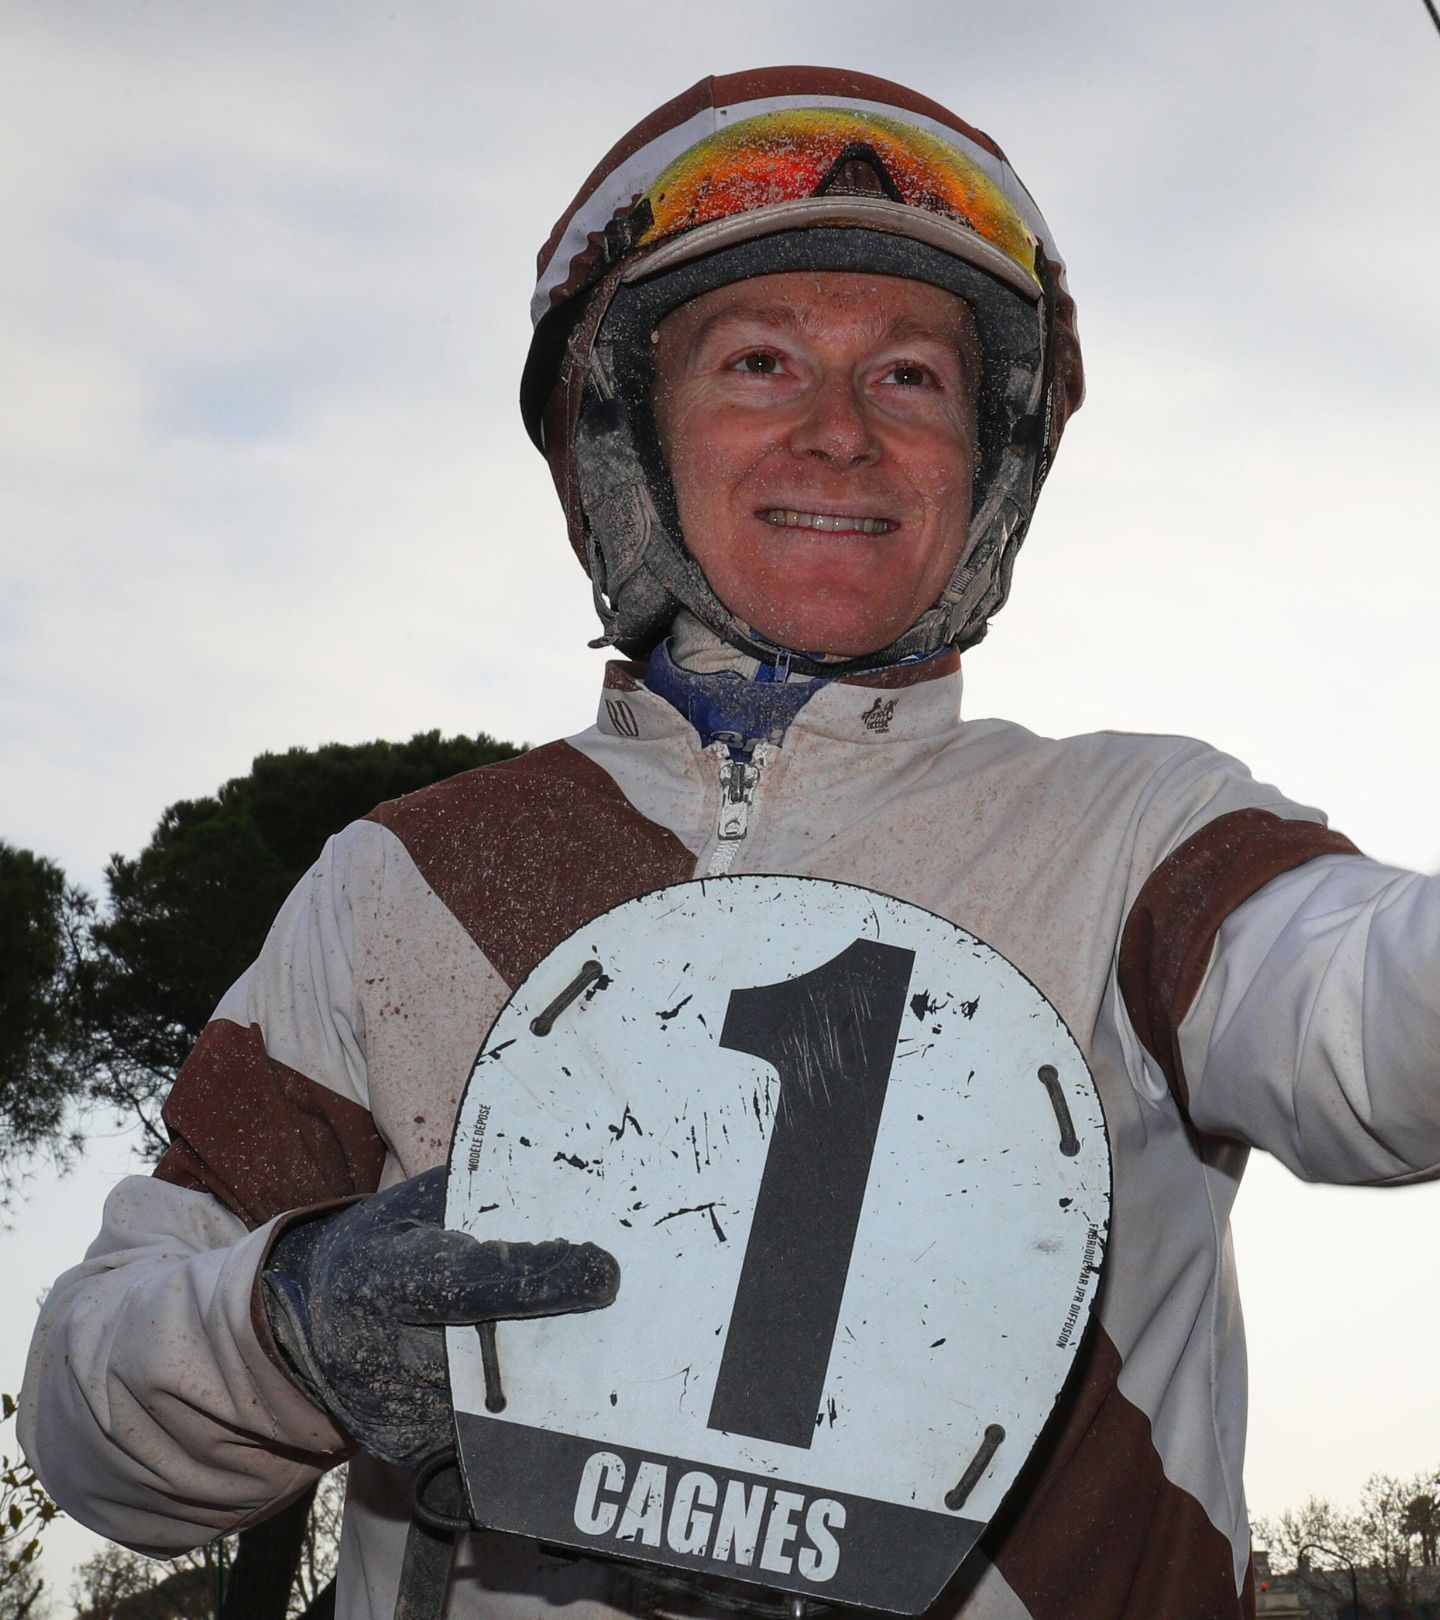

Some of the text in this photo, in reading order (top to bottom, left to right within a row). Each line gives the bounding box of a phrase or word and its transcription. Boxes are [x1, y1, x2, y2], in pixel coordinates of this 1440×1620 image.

[468, 1103, 491, 1171] MODÈLE DÉPOSÉ
[706, 938, 916, 1450] 1
[1073, 1286, 1086, 1303] JPR
[1079, 1267, 1092, 1286] PAR
[1056, 1303, 1081, 1350] DIFFUSION
[573, 1451, 847, 1583] CAGNES
